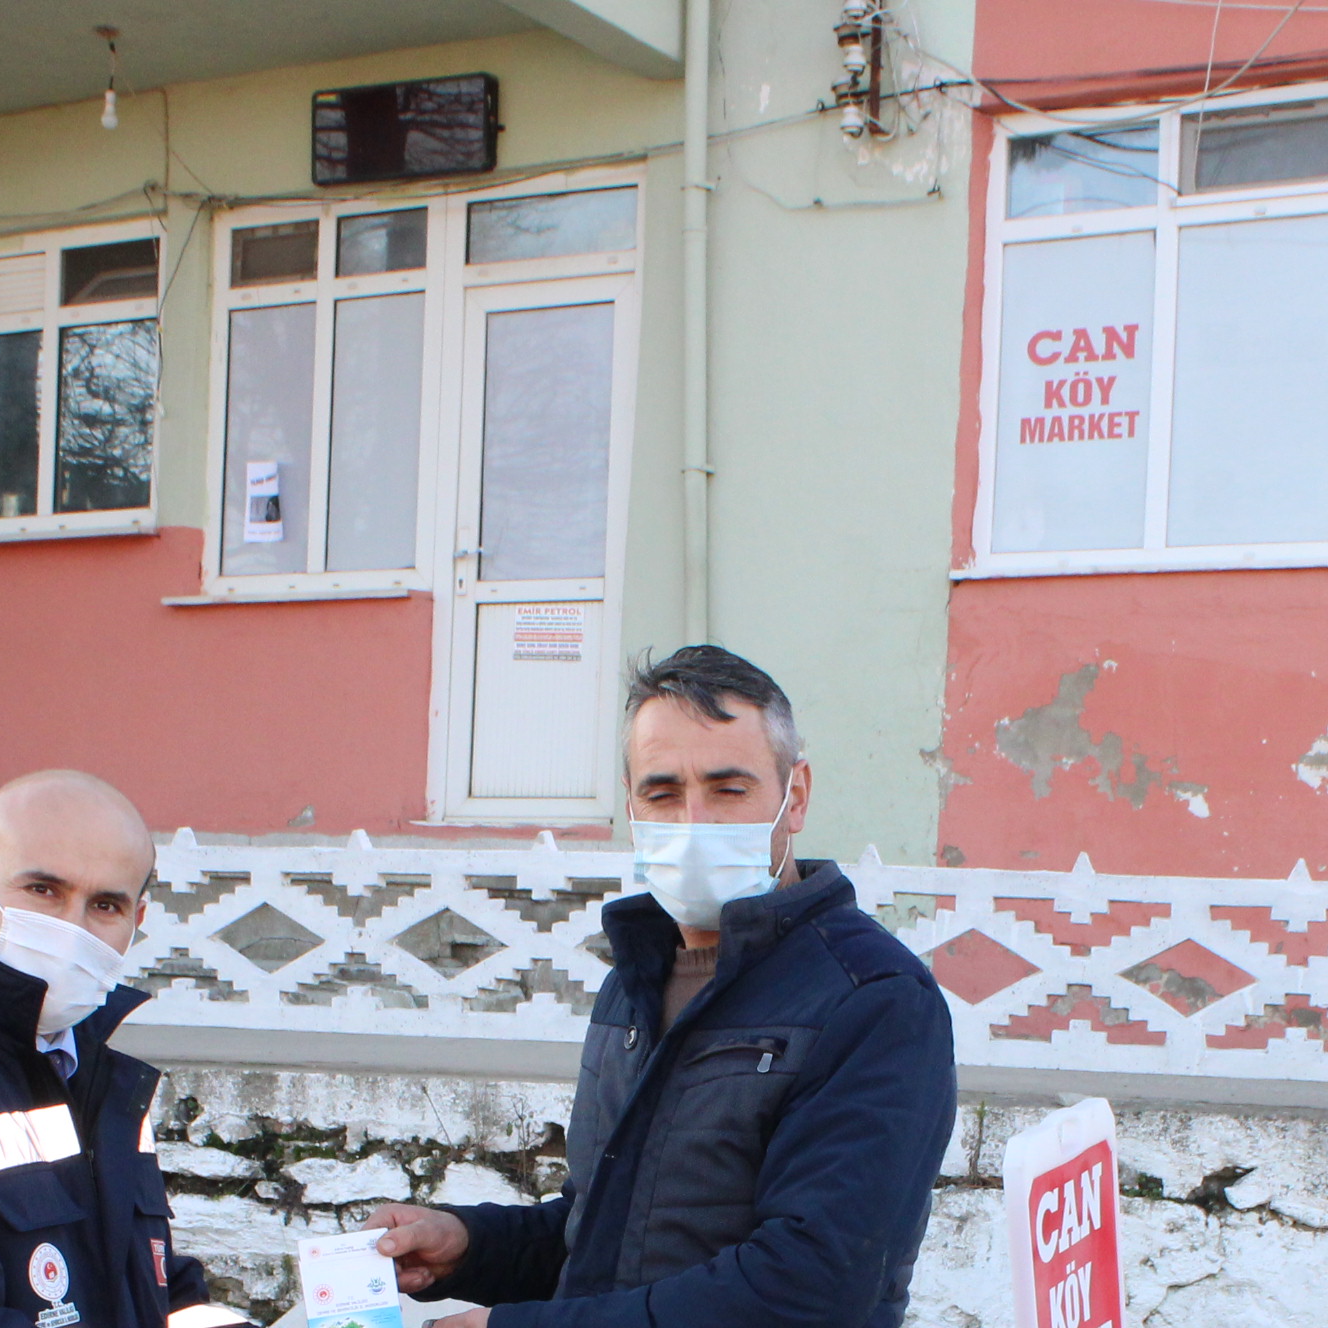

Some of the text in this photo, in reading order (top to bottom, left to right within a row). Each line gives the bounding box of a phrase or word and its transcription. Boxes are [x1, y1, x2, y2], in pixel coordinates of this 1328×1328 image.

[1027, 323, 1140, 367] CAN
[1043, 371, 1117, 409] KÖY
[1019, 410, 1140, 445] MARKET
[544, 607, 582, 615] PETROL
[1035, 1161, 1103, 1263] CAN
